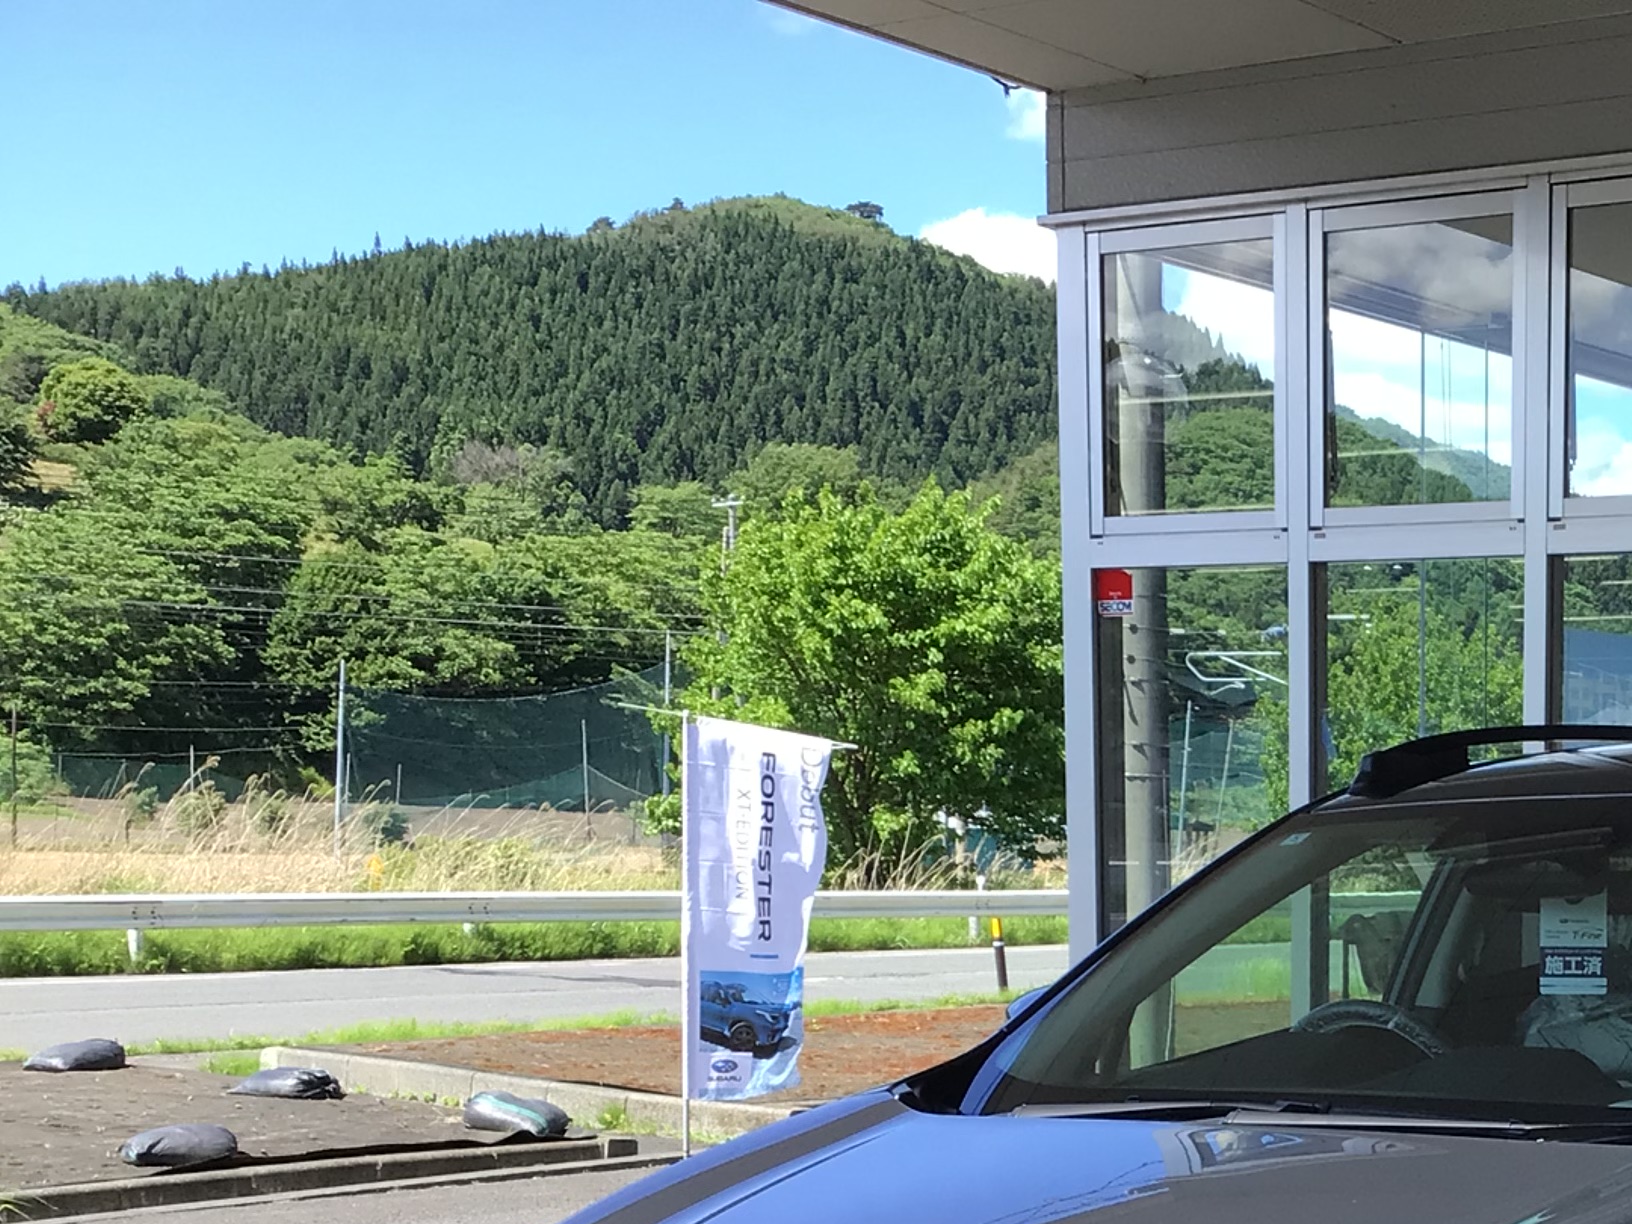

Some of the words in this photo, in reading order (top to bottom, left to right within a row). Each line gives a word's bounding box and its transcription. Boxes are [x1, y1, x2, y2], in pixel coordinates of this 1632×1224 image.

[757, 752, 776, 942] FORESTER
[1544, 955, 1603, 976] 施工済
